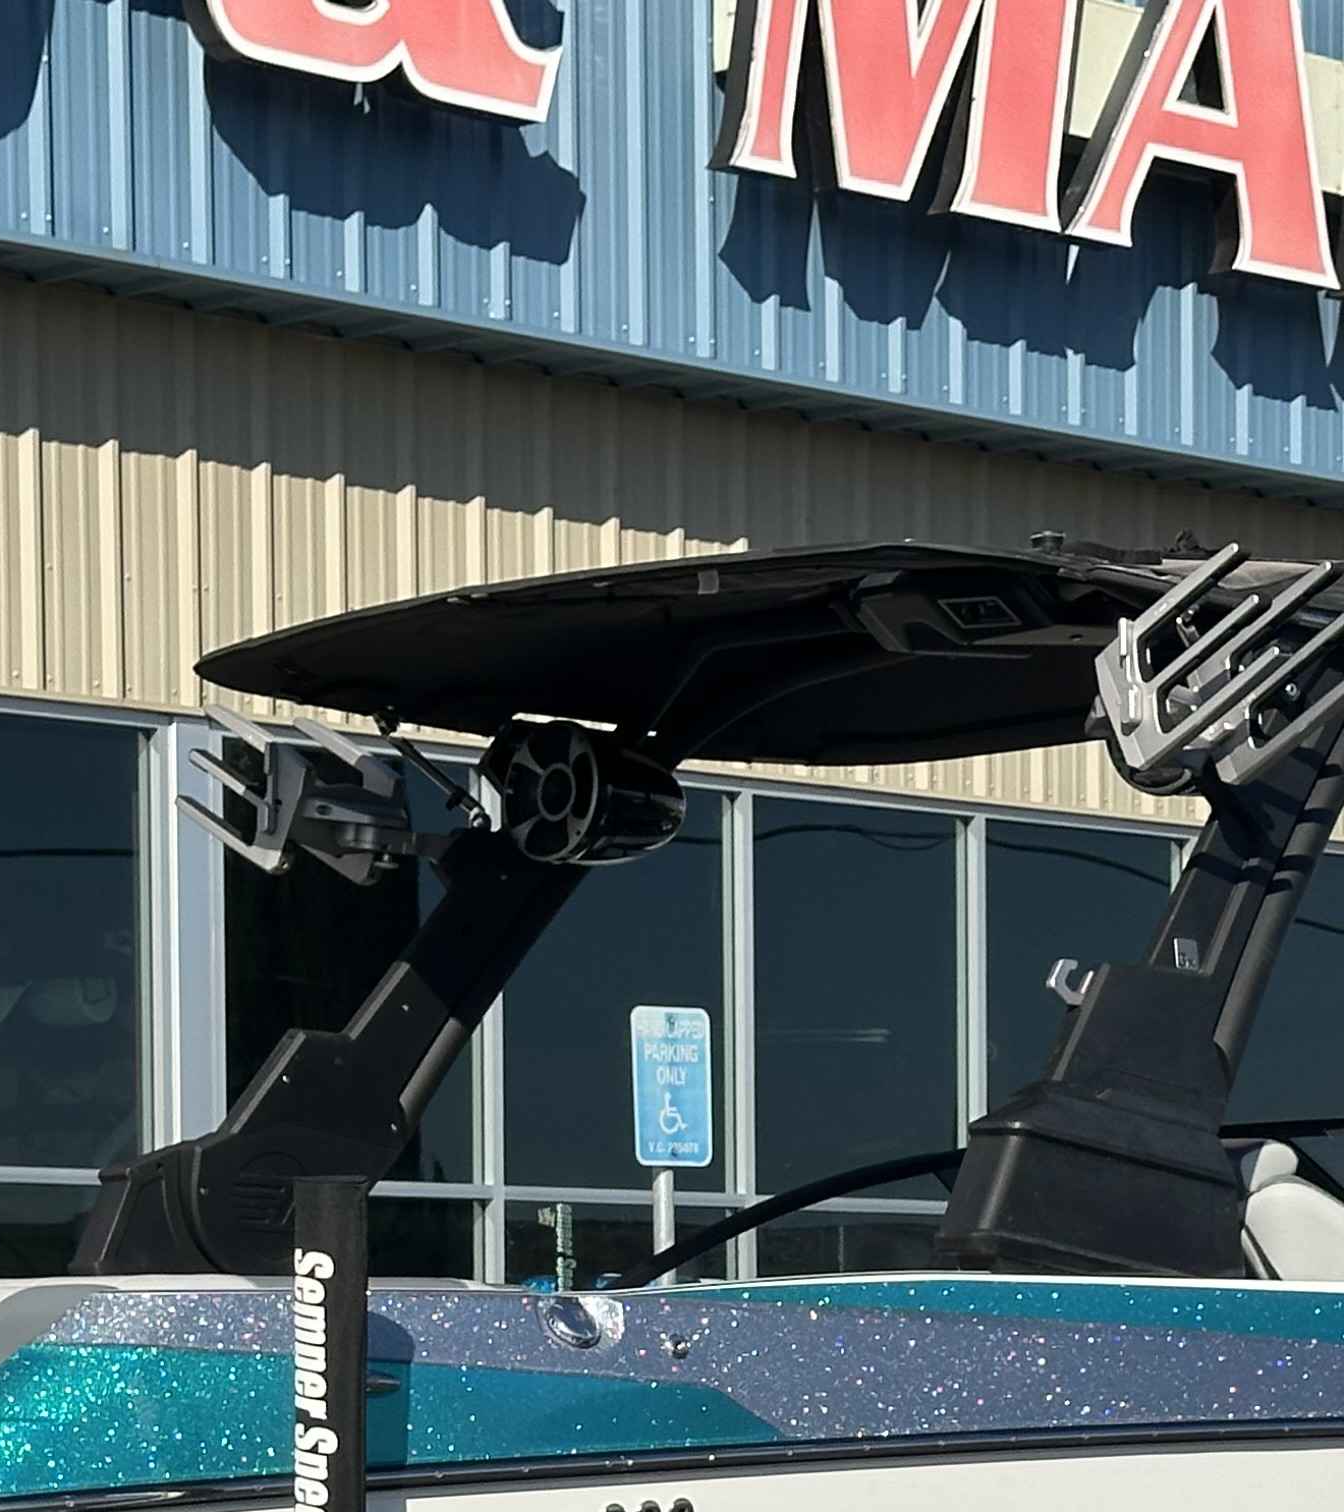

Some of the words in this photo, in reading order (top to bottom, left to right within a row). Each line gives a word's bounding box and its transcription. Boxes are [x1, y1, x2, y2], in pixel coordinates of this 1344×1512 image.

[643, 1043, 699, 1064] PARKING
[656, 1064, 688, 1086] ONLY
[293, 1247, 335, 1421] Semper
